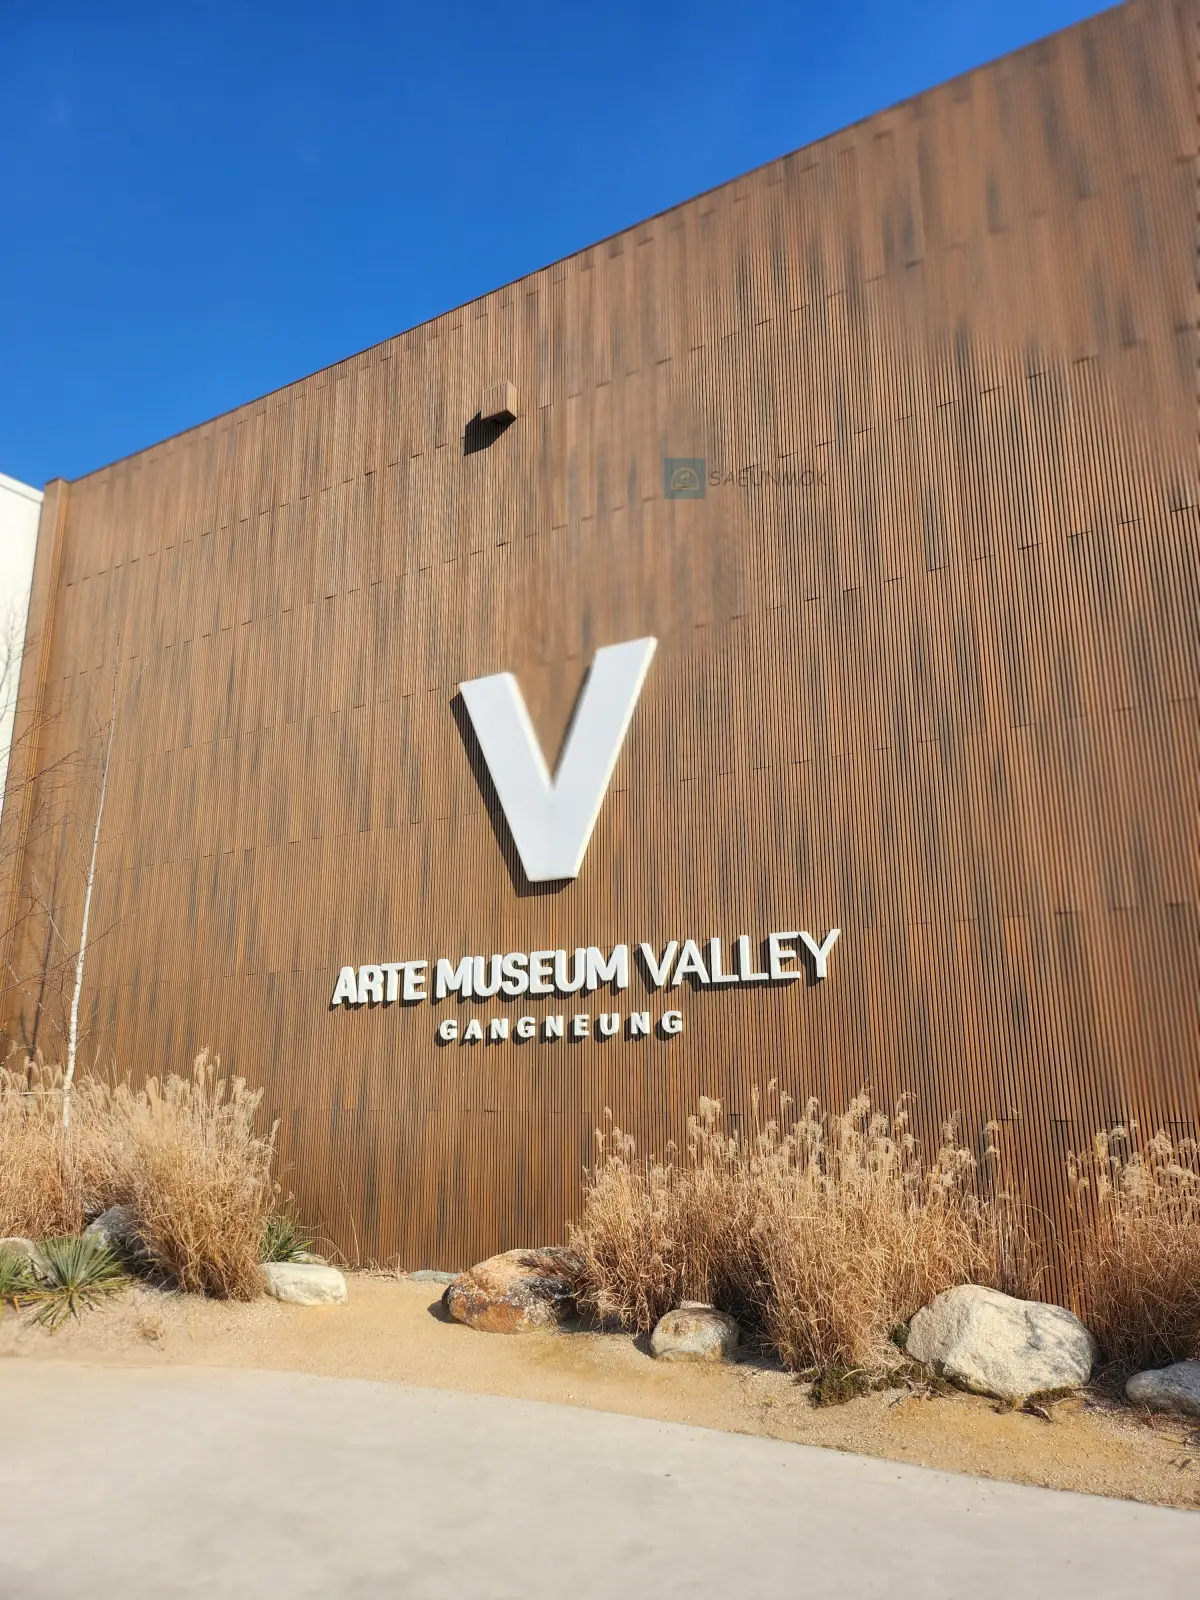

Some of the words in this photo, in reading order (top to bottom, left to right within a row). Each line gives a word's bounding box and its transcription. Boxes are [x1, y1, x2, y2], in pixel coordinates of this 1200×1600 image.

[458, 635, 658, 881] V
[332, 963, 428, 1004] ARTE
[436, 944, 630, 998] MUSEUM
[639, 928, 841, 987] VALLEY
[440, 1010, 682, 1040] GANGNEUNG
